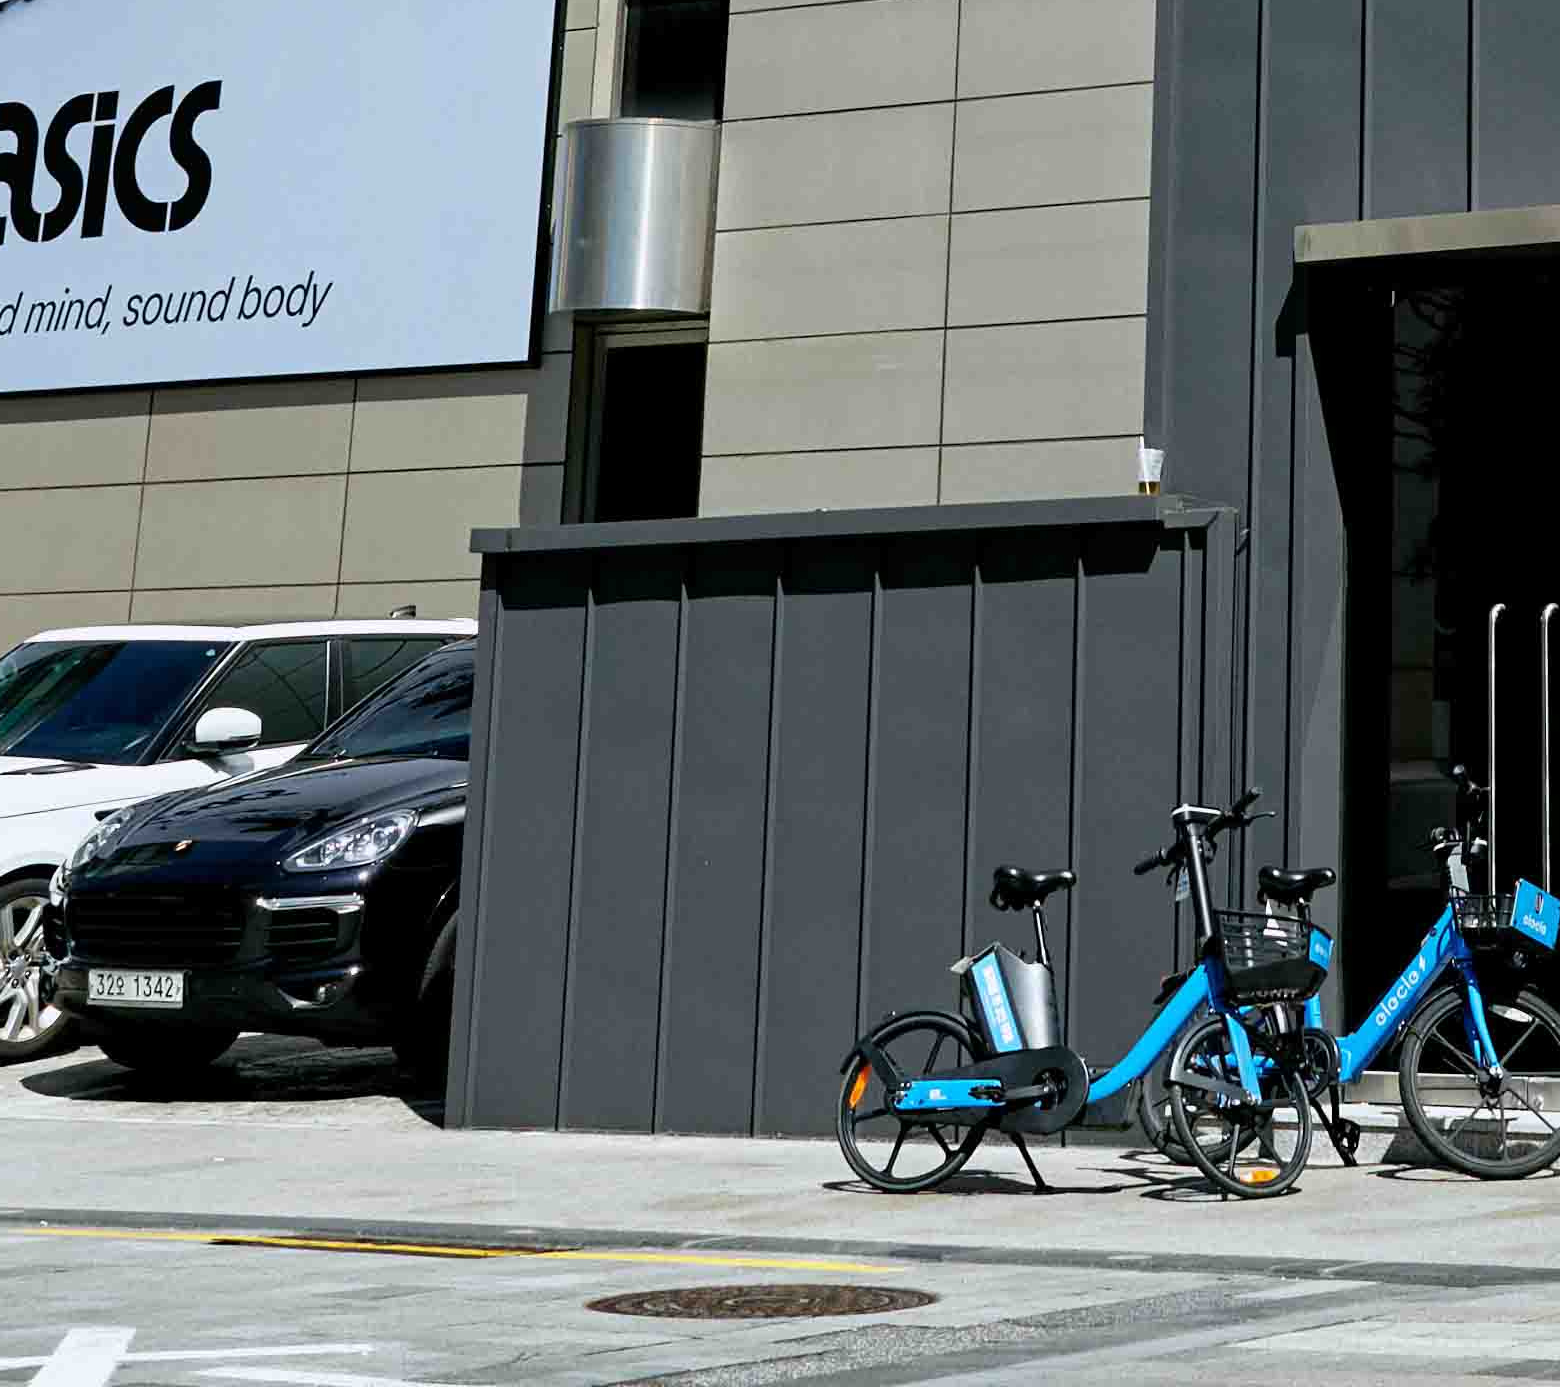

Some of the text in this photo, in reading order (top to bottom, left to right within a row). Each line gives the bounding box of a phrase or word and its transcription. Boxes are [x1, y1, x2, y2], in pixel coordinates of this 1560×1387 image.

[23, 284, 113, 335] mind,
[122, 276, 236, 328] sound
[238, 270, 333, 328] body
[133, 974, 174, 998] 1342
